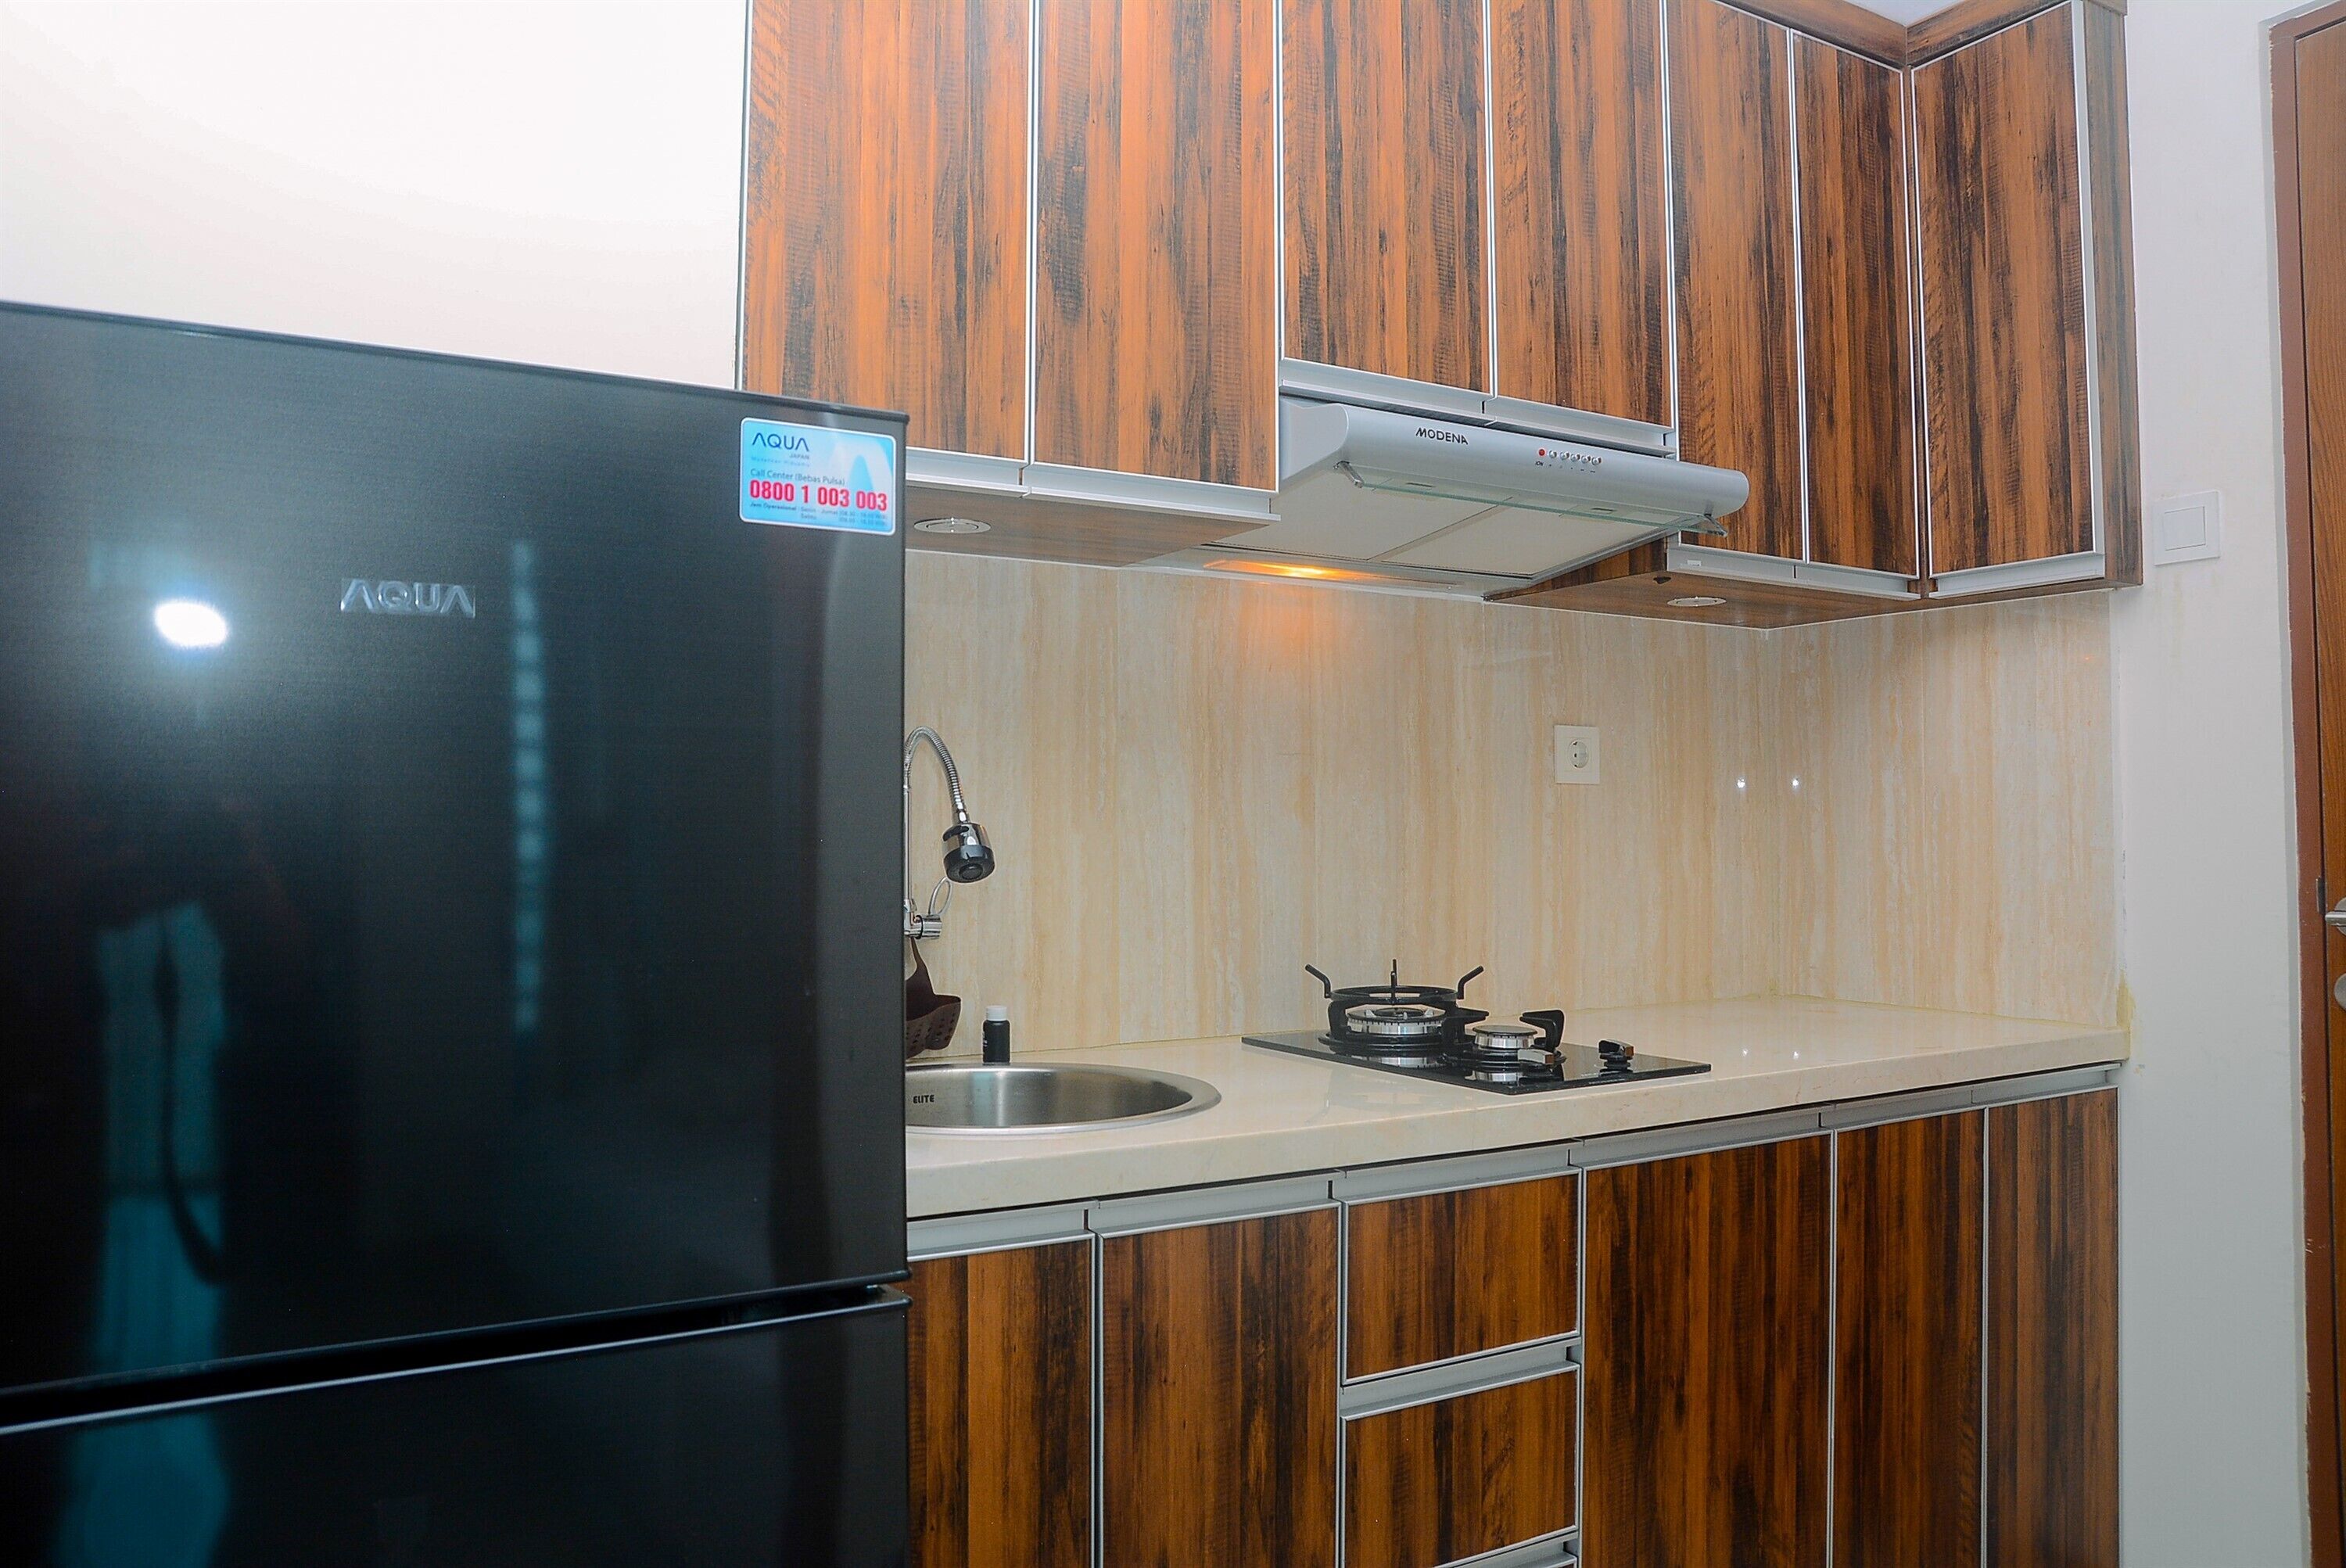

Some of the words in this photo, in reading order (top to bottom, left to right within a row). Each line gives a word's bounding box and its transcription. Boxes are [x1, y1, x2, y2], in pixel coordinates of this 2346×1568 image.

[752, 432, 809, 451] AQUA
[1415, 427, 1469, 445] MODENA
[751, 468, 765, 477] Call
[767, 470, 793, 481] Center
[795, 473, 821, 484] (Bebas
[823, 476, 845, 486] Pulsa)
[750, 479, 795, 501] 0800
[802, 485, 809, 504] 1
[817, 486, 849, 508] 003
[856, 491, 887, 511] 003
[340, 579, 475, 619] AQUA
[913, 1094, 934, 1103] ELITE
